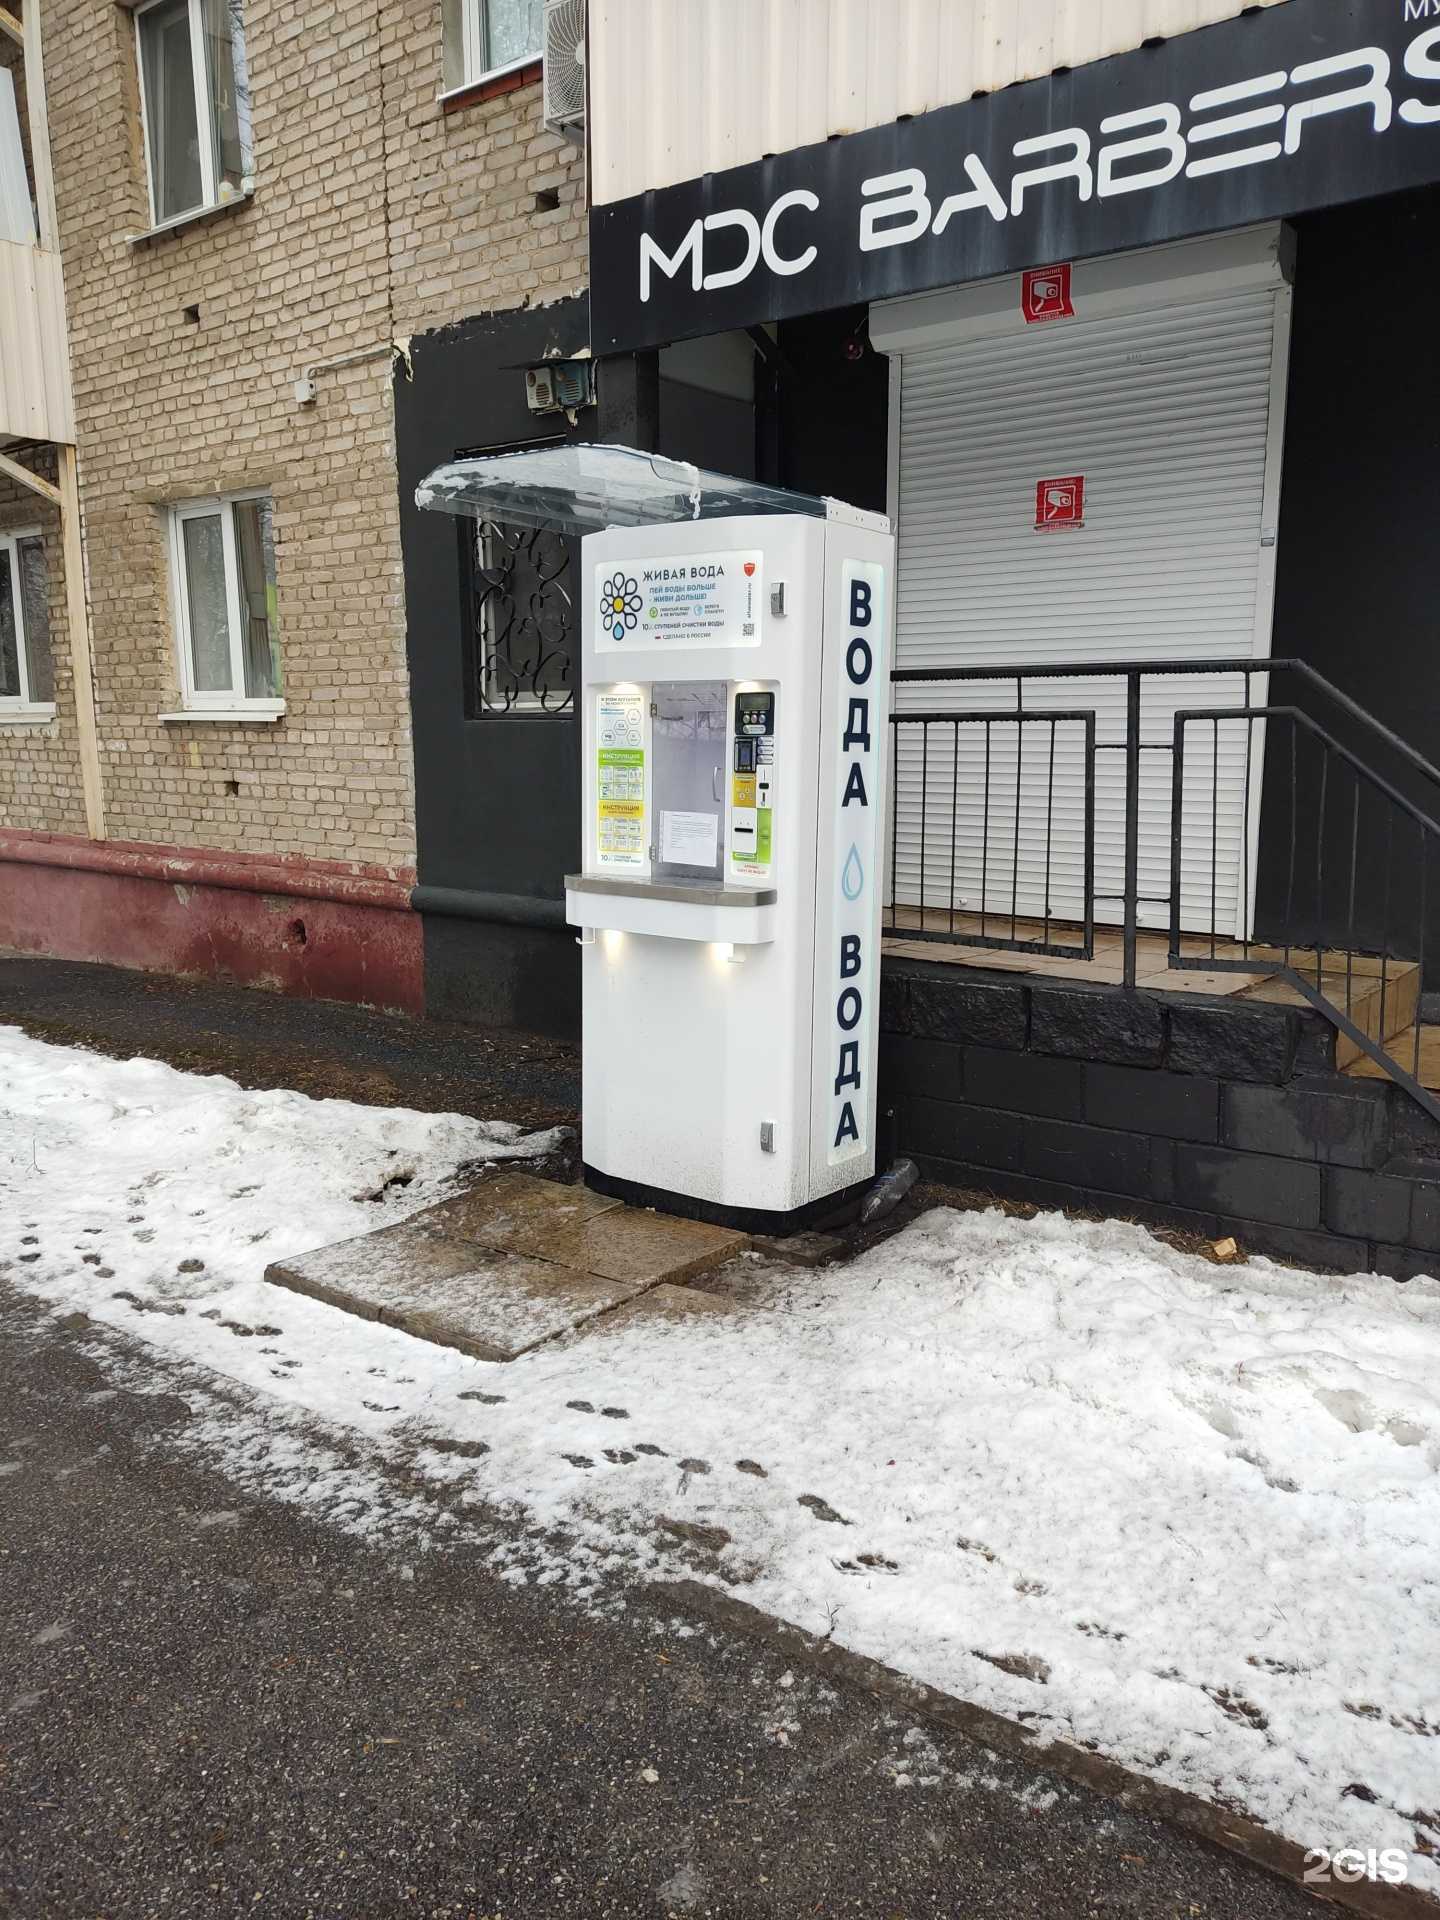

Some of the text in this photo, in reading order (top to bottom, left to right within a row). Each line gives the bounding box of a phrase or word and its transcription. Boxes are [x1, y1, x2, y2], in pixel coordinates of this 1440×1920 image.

[640, 189, 819, 302] MDC
[643, 565, 725, 582] ЖИВАЯ ВОДА
[841, 579, 873, 807] ВОДА
[834, 934, 862, 1148] ВОДА
